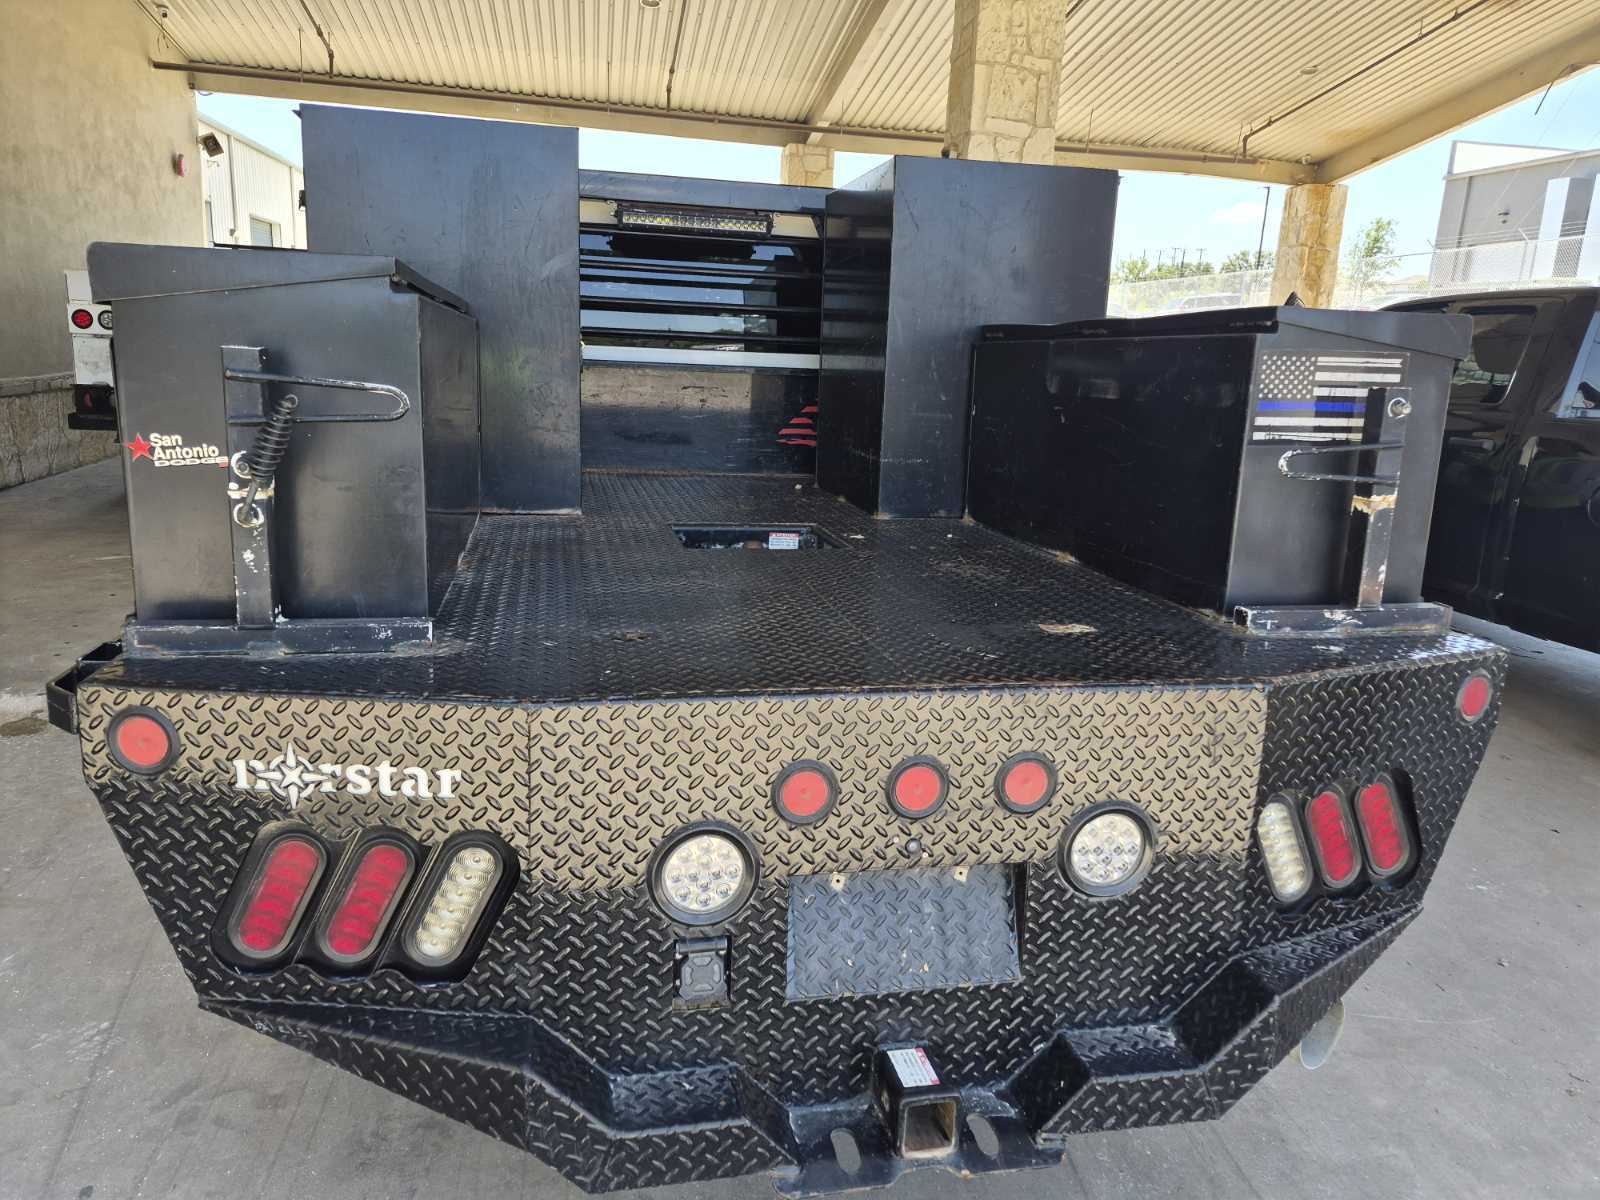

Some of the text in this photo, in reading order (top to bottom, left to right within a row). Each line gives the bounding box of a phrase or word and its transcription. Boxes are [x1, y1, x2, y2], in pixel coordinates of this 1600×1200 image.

[149, 432, 183, 447] San
[153, 443, 220, 460] Antonio
[154, 456, 229, 467] DODGE
